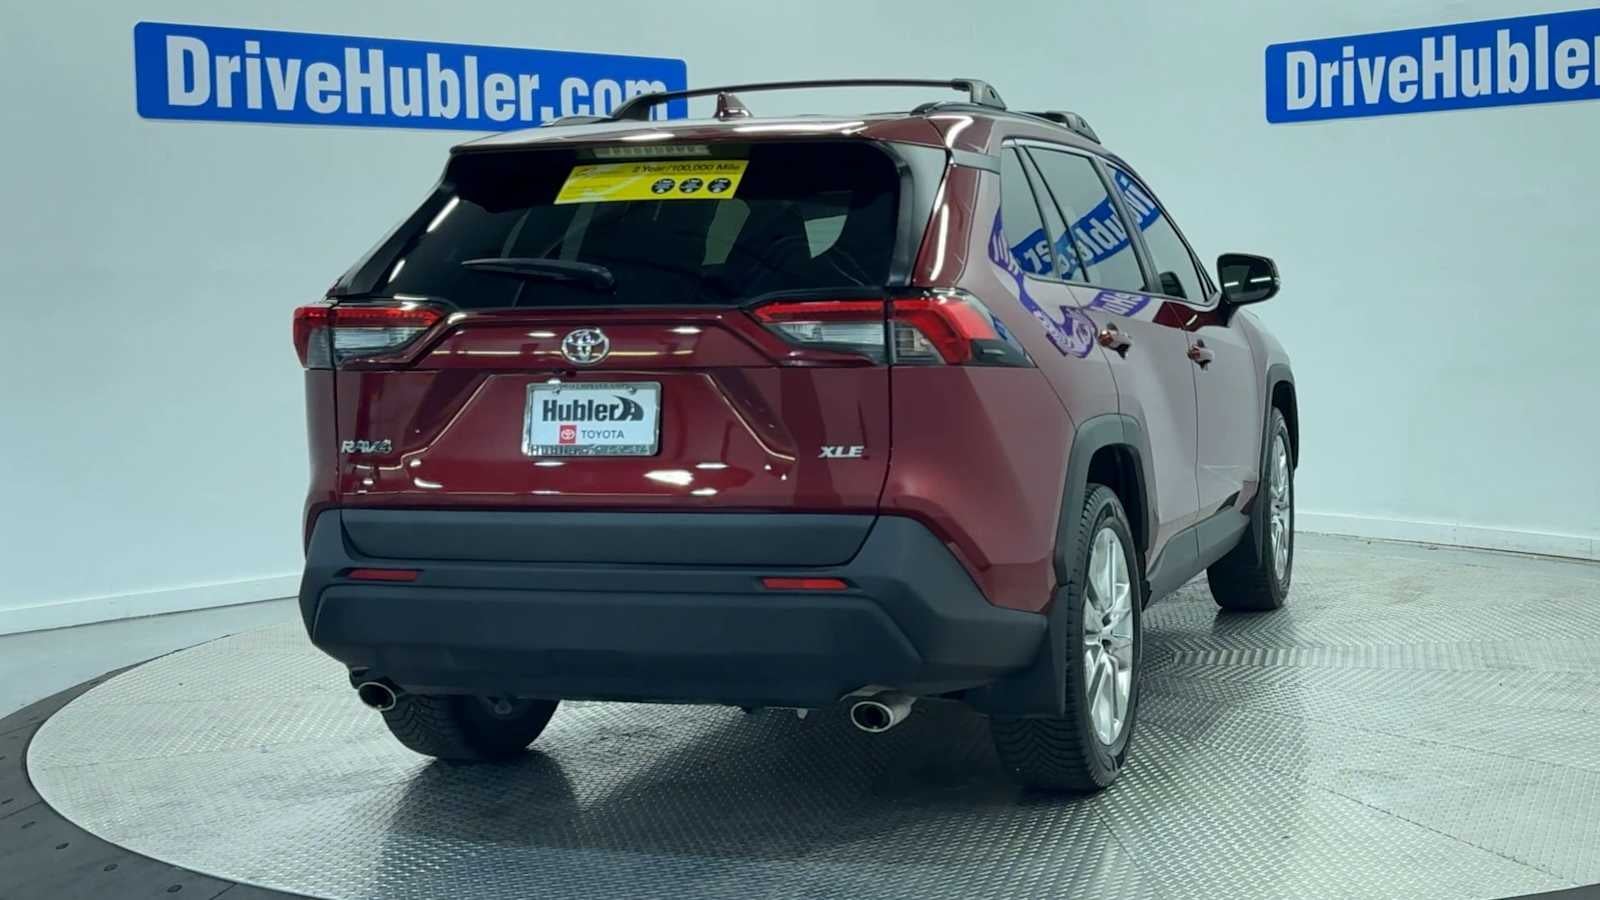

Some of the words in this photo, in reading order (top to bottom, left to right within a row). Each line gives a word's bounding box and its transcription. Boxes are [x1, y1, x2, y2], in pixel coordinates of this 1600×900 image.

[166, 35, 668, 122] DriveHubler.com
[542, 399, 620, 422] Hubler
[581, 429, 625, 440] TOYOTA
[341, 439, 392, 454] RAV4
[817, 446, 865, 458] XLE
